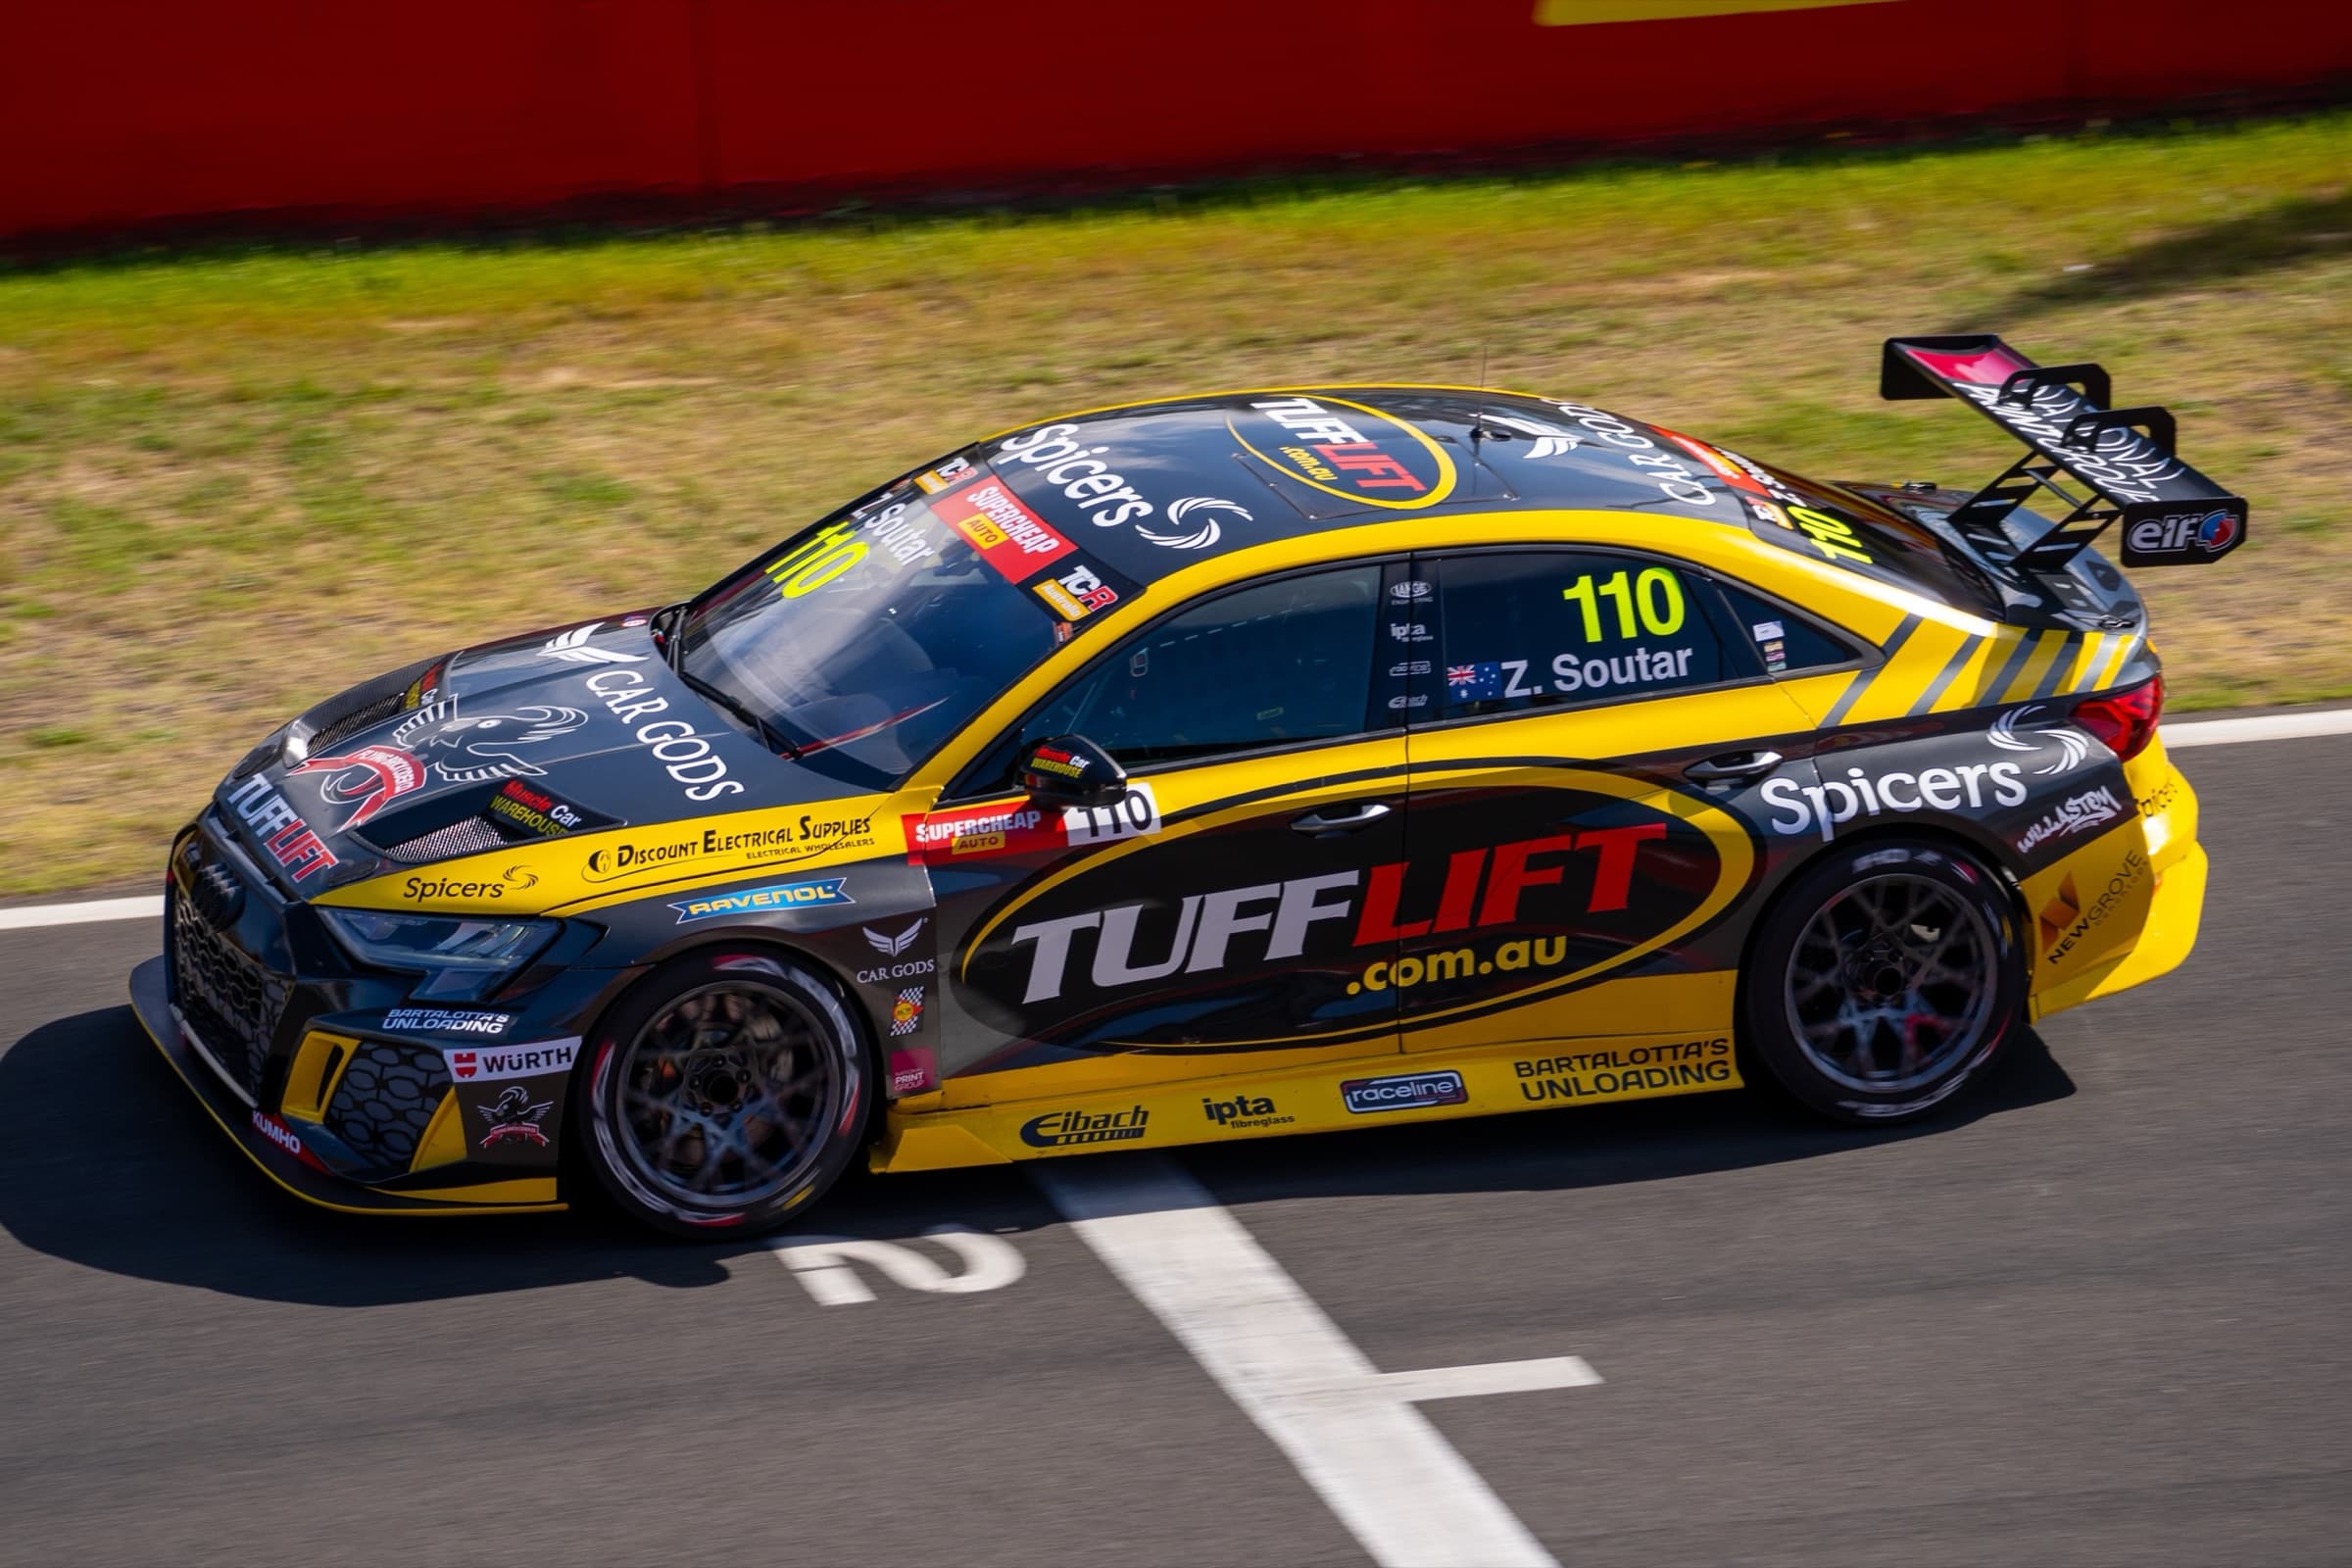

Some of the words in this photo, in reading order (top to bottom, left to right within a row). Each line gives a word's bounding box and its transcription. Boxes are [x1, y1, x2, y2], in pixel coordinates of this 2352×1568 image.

[998, 423, 1154, 528] Spicers
[1627, 453, 1717, 506] CAR
[864, 503, 936, 566] Soutar
[966, 486, 1060, 554] SUPERCHEAP
[968, 518, 999, 544] AUTO
[1786, 506, 1874, 564] 110
[2130, 516, 2200, 550] elf
[764, 521, 870, 599] 110
[1041, 583, 1082, 617] Australia
[1057, 564, 1119, 612] TCR
[1562, 566, 1686, 643] 110
[1500, 660, 1544, 699] Z.
[1552, 647, 1693, 692] Soutar
[585, 669, 669, 724] CAR
[636, 720, 746, 802] GODS
[1030, 757, 1083, 779] WAREHOUSE
[1069, 756, 1091, 769] Car
[502, 780, 552, 812] Muscle
[550, 805, 582, 828] Car
[1077, 789, 1152, 839] 110
[1759, 761, 2029, 843] Spicers
[226, 772, 340, 883] TUFFLIFT
[914, 809, 1042, 843] SUPERCHEAP
[957, 836, 1000, 851] AUTO
[746, 846, 801, 859] ELECTRICAL
[804, 837, 875, 854] WHOLESALERS
[403, 877, 505, 903] Spicers
[688, 887, 838, 915] RAVENOL
[2047, 850, 2143, 964] NEWGROVE
[1010, 821, 1668, 1004] TUFFLIFT
[856, 966, 890, 984] CAR
[891, 958, 936, 978] GODS
[1346, 935, 1568, 996] .com.au
[381, 1017, 504, 1034] UNLOADING
[387, 1008, 511, 1023] BARTALOTTA'S
[895, 1072, 923, 1084] PRINT
[1513, 1038, 1729, 1078] BARTALOTTA'S
[1349, 1079, 1454, 1102] raceline
[1520, 1059, 1731, 1102] UNLOADING
[252, 1109, 302, 1154] KUMHO
[1020, 1104, 1151, 1148] Eibach
[1201, 1095, 1276, 1126] ipta
[1230, 1114, 1296, 1130] fibreglass
